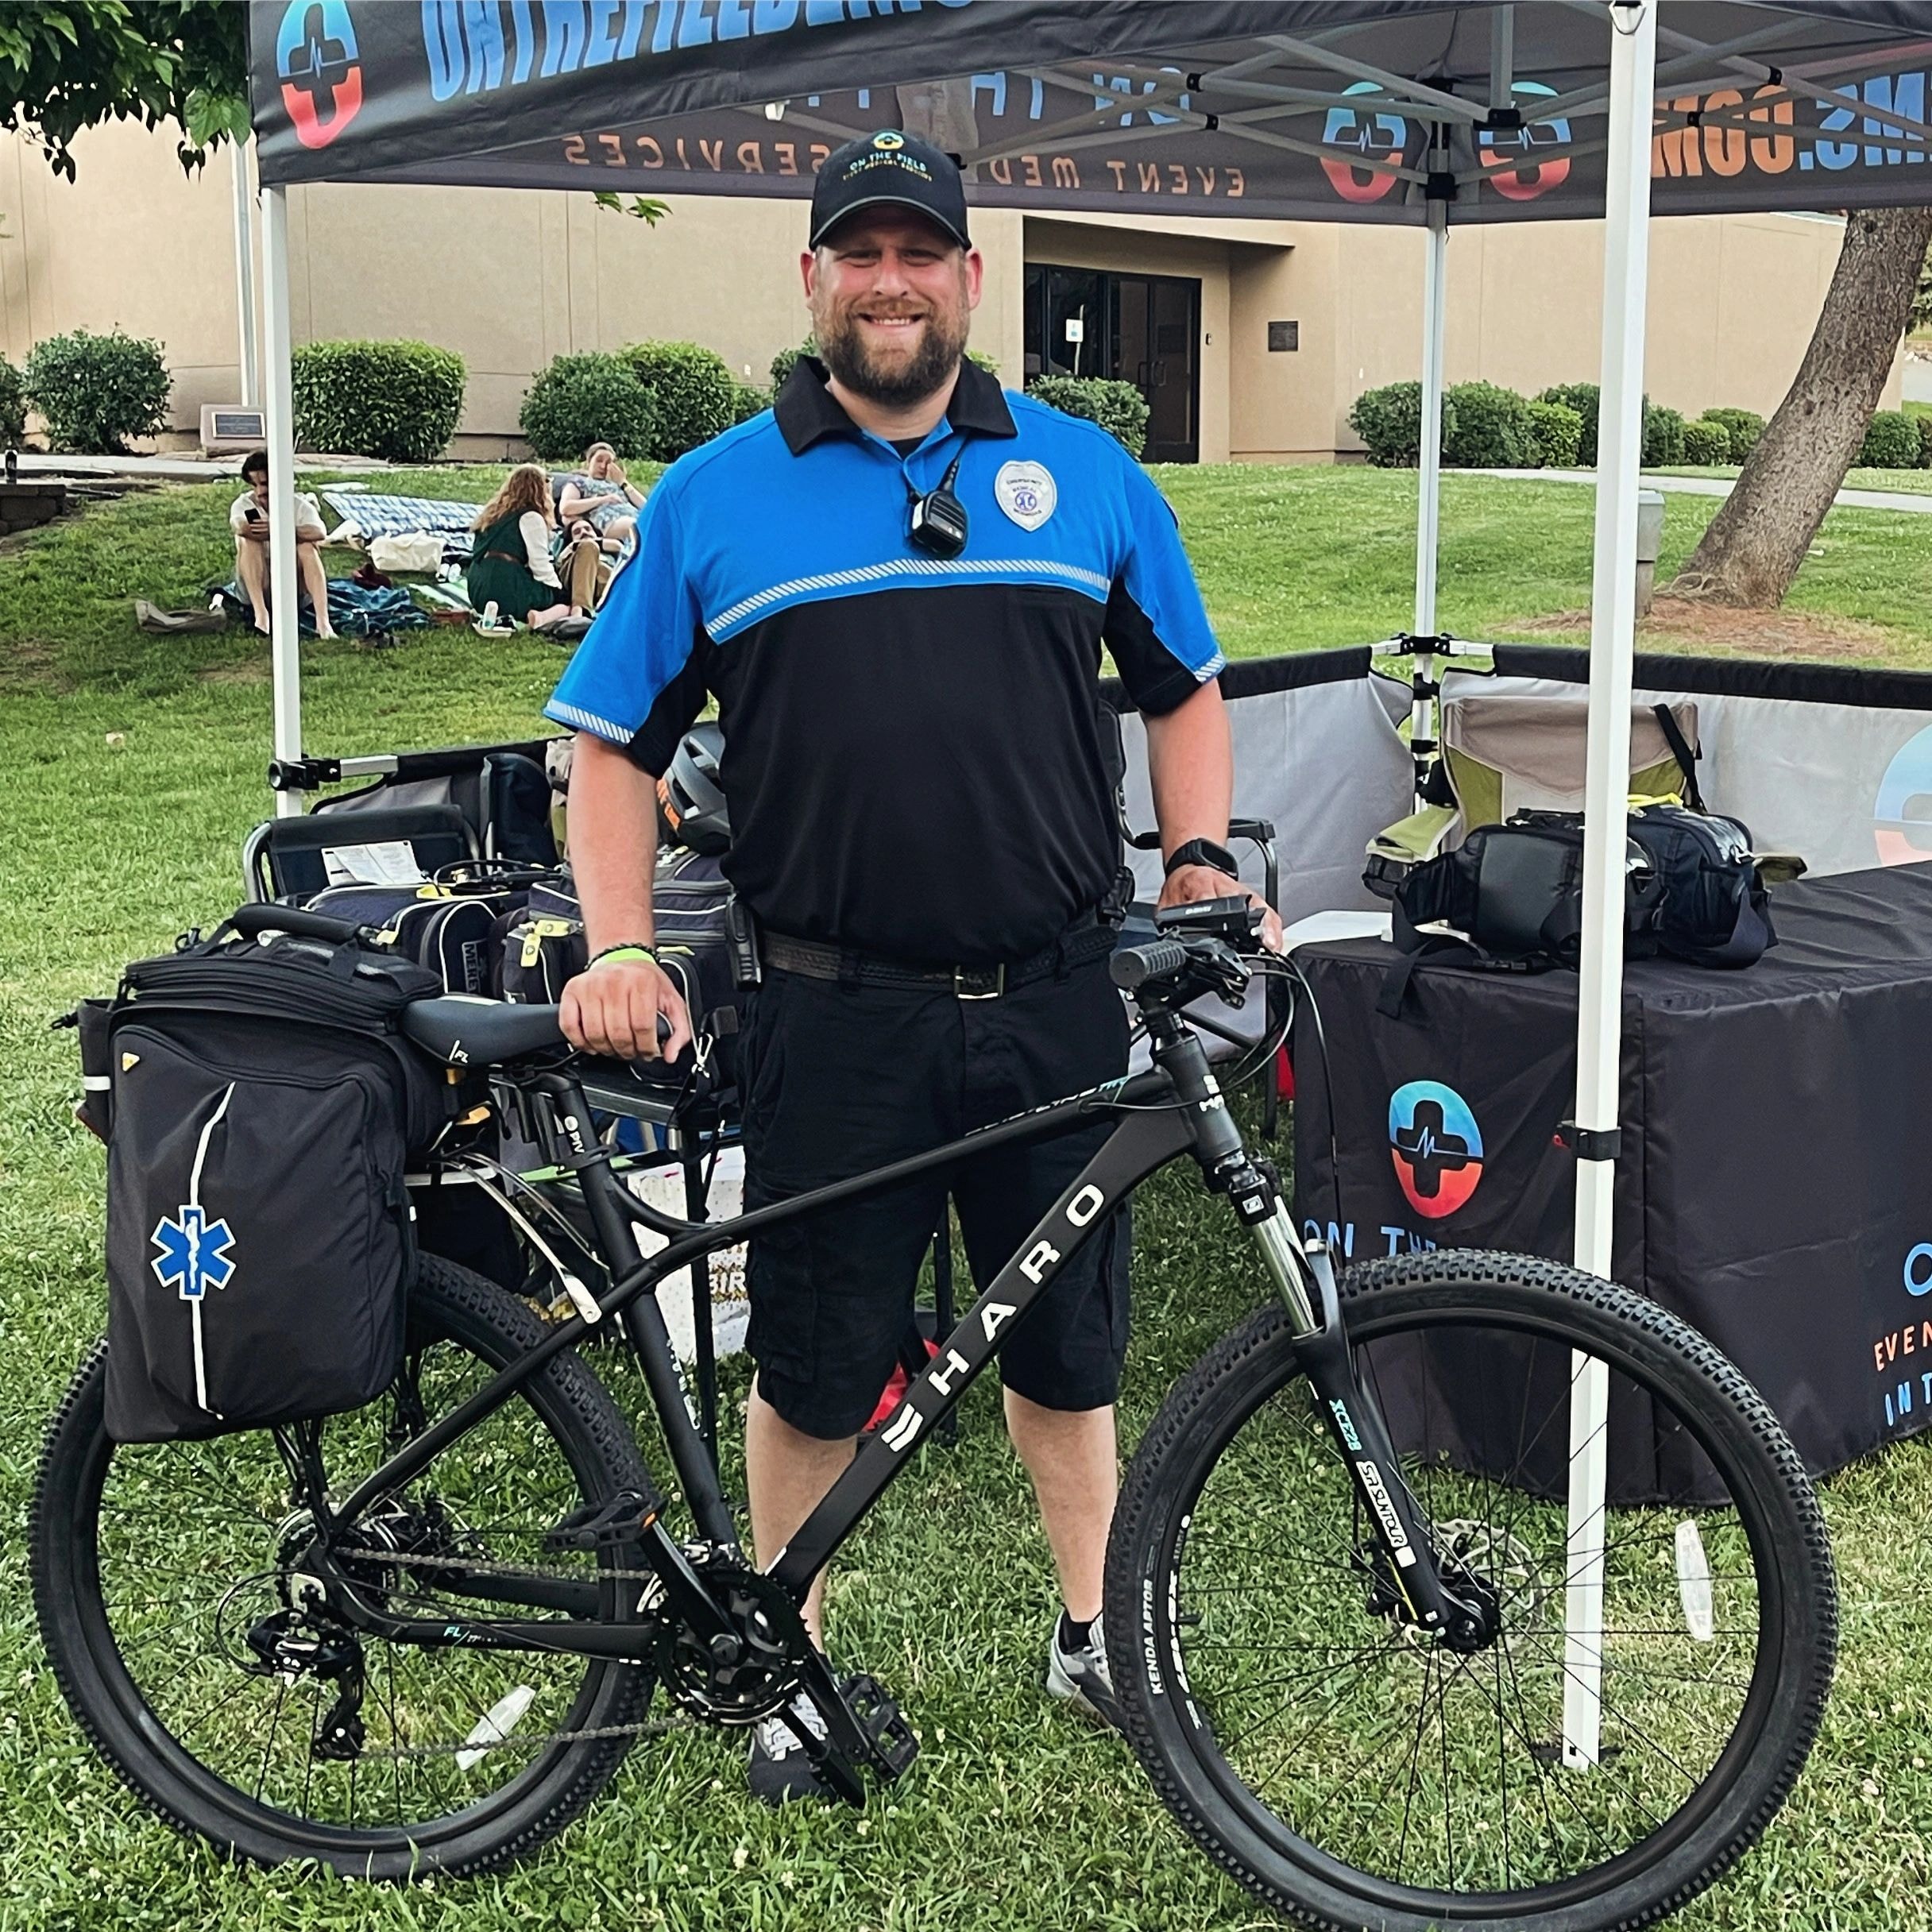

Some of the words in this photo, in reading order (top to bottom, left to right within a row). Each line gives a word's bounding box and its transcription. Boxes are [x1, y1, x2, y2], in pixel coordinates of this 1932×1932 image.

[849, 157, 866, 171] ON
[870, 151, 891, 161] THE
[897, 153, 927, 172] FIELD
[928, 1184, 1105, 1397] HARO
[1885, 1381, 1912, 1427] IN
[1370, 1486, 1406, 1546] SUNTOUR
[1142, 1578, 1154, 1636] APTOR
[1143, 1636, 1165, 1695] KENDA
